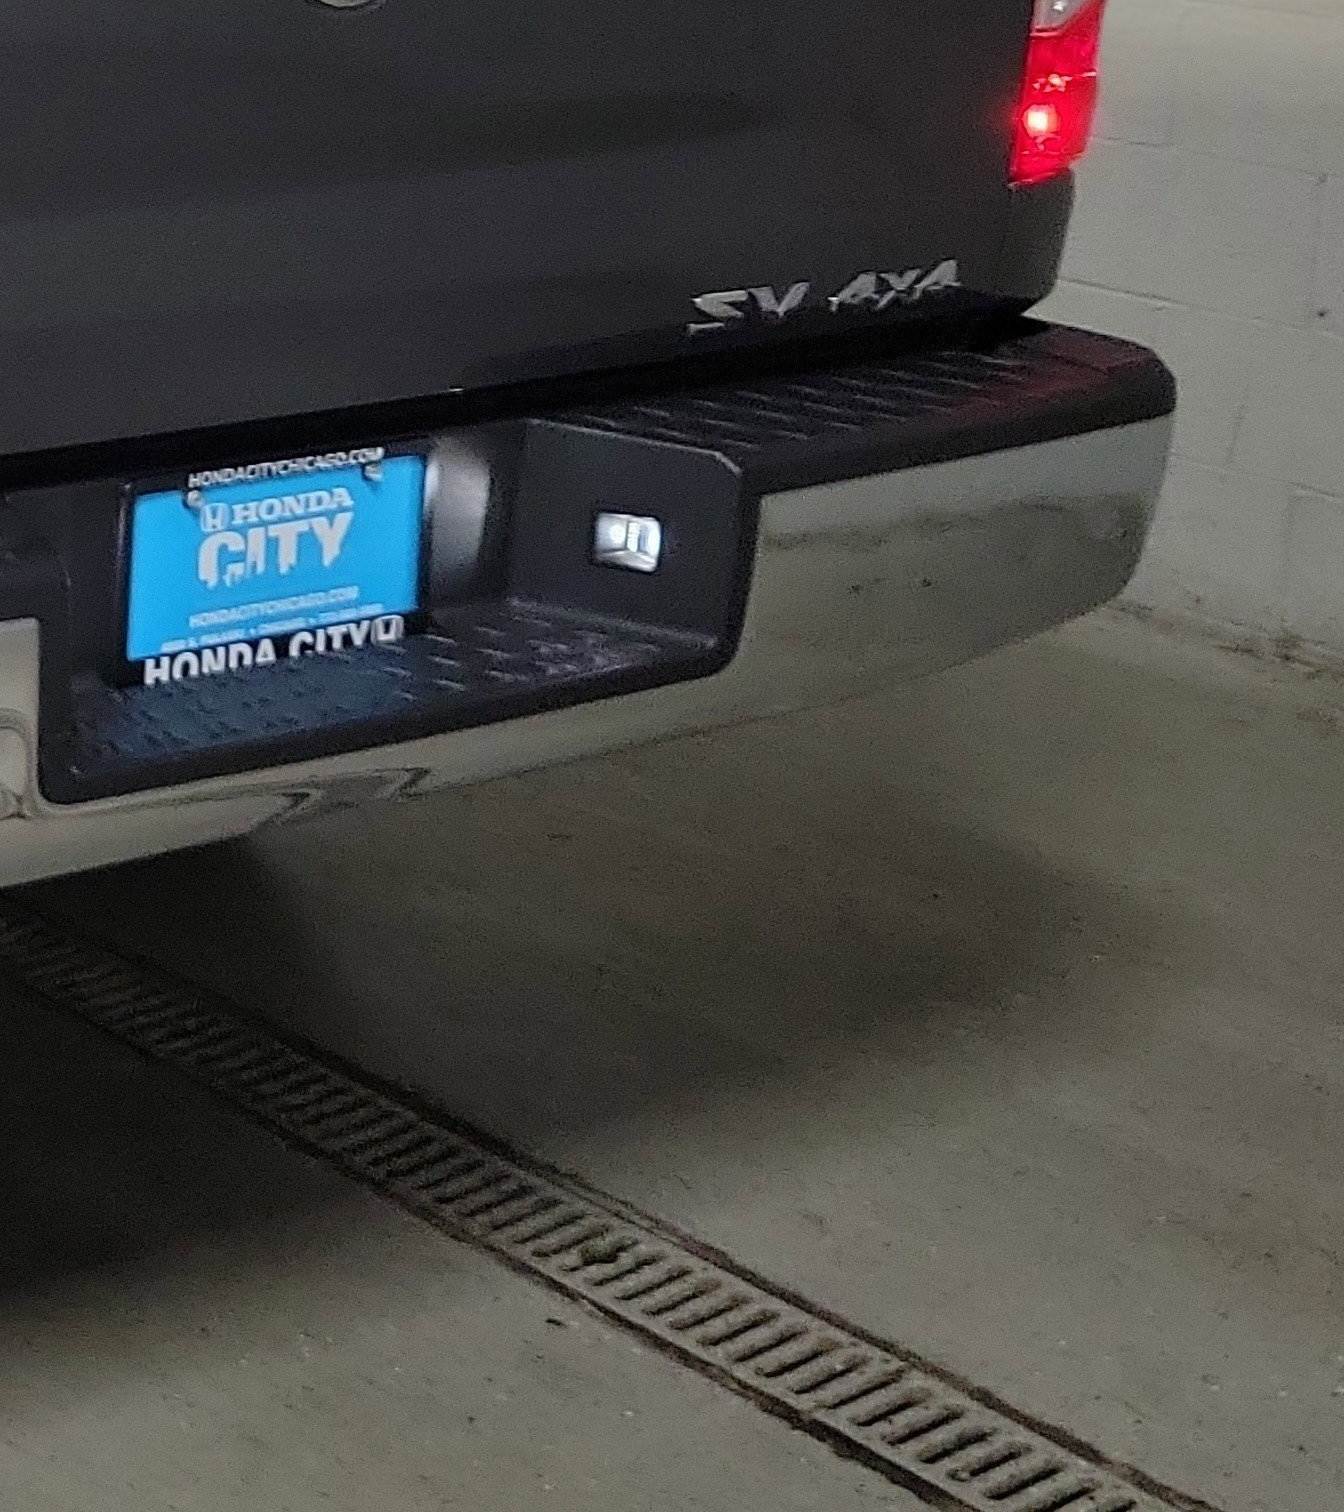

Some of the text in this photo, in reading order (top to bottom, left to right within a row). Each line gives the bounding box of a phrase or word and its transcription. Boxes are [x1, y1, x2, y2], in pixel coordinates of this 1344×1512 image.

[686, 281, 810, 335] SV
[230, 487, 355, 525] HONDA
[198, 512, 354, 589] CITY
[143, 638, 277, 686] HONDA
[288, 619, 372, 659] CITY
